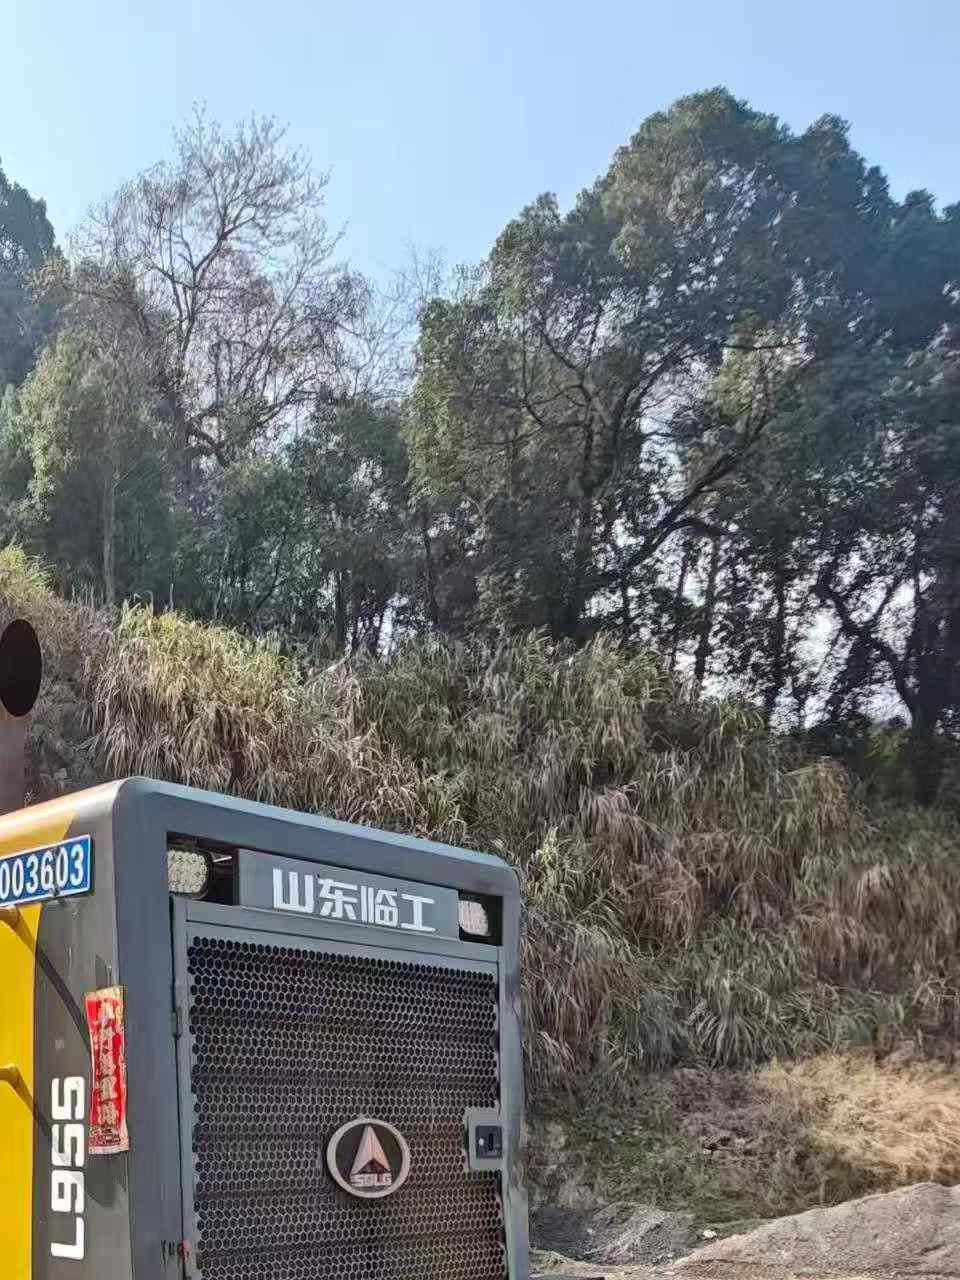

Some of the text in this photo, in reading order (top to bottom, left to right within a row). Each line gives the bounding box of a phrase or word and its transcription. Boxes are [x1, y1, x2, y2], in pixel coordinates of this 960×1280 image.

[272, 868, 437, 933] 山东临工
[51, 1076, 85, 1261] L955
